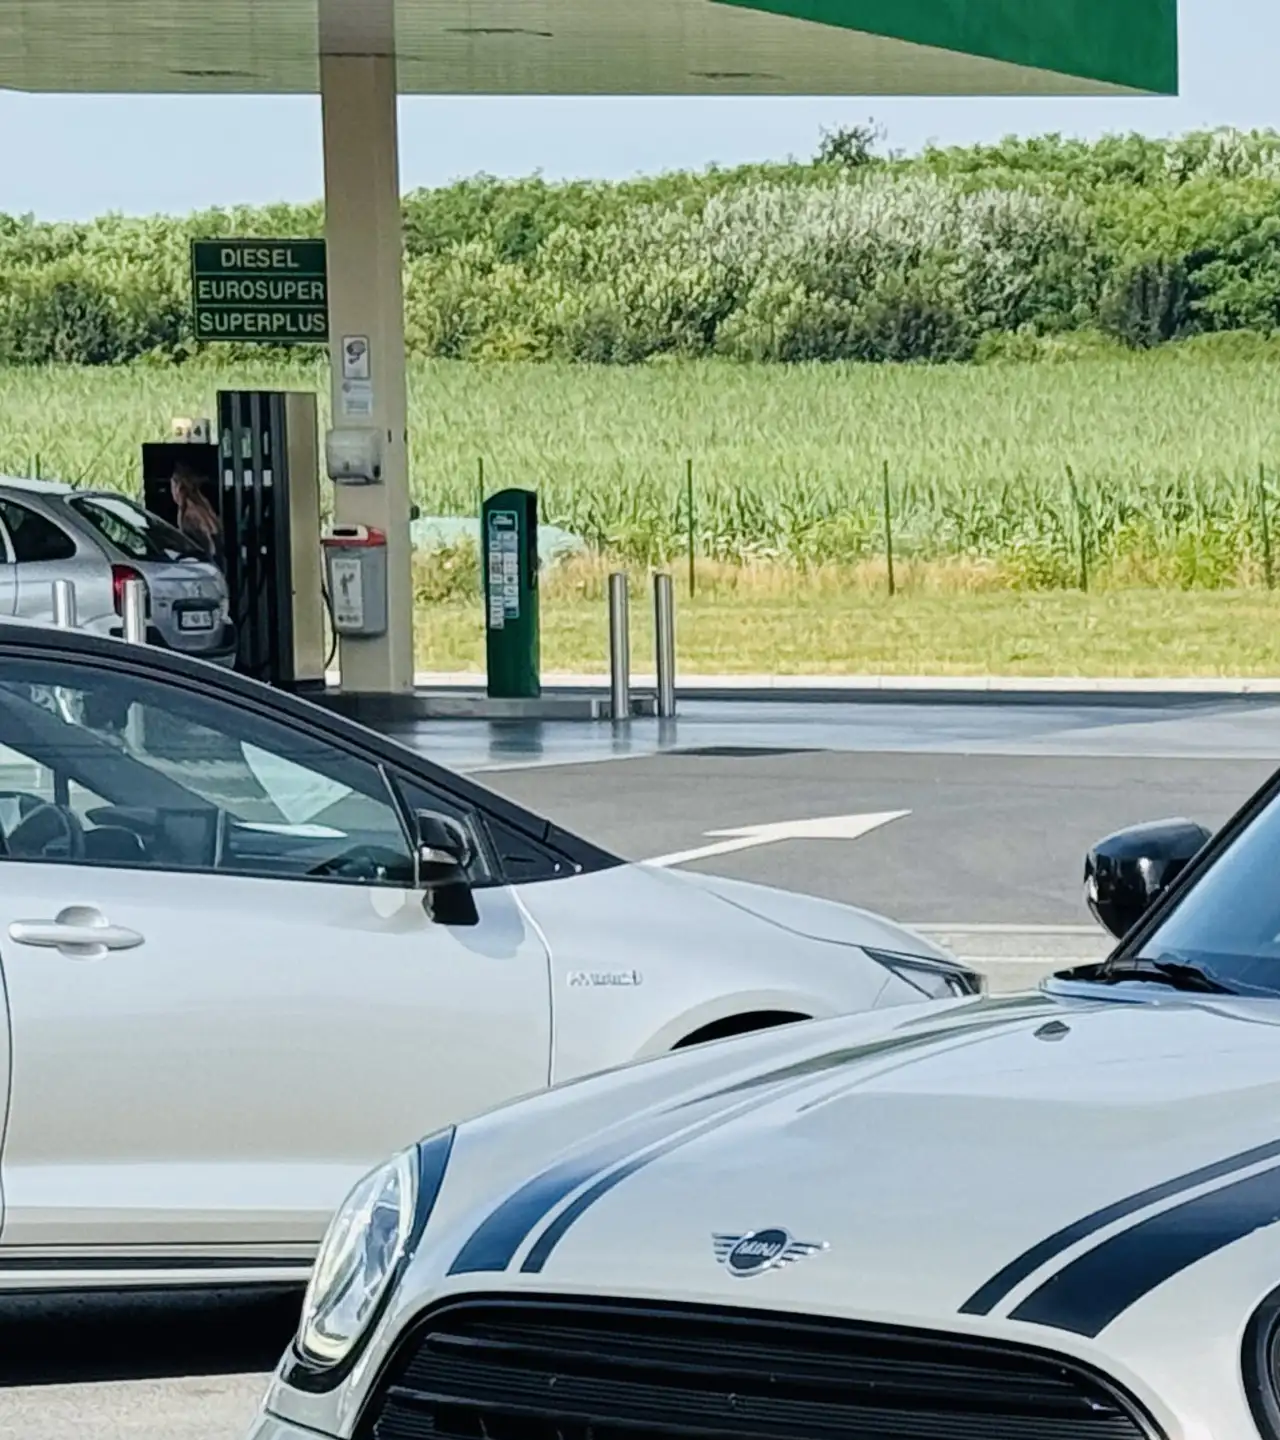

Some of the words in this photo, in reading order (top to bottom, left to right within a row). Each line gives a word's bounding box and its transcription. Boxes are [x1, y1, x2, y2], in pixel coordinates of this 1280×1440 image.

[220, 247, 300, 269] DIESEL
[198, 279, 325, 301] EUROSUPER
[199, 311, 326, 333] SUPERPLUS
